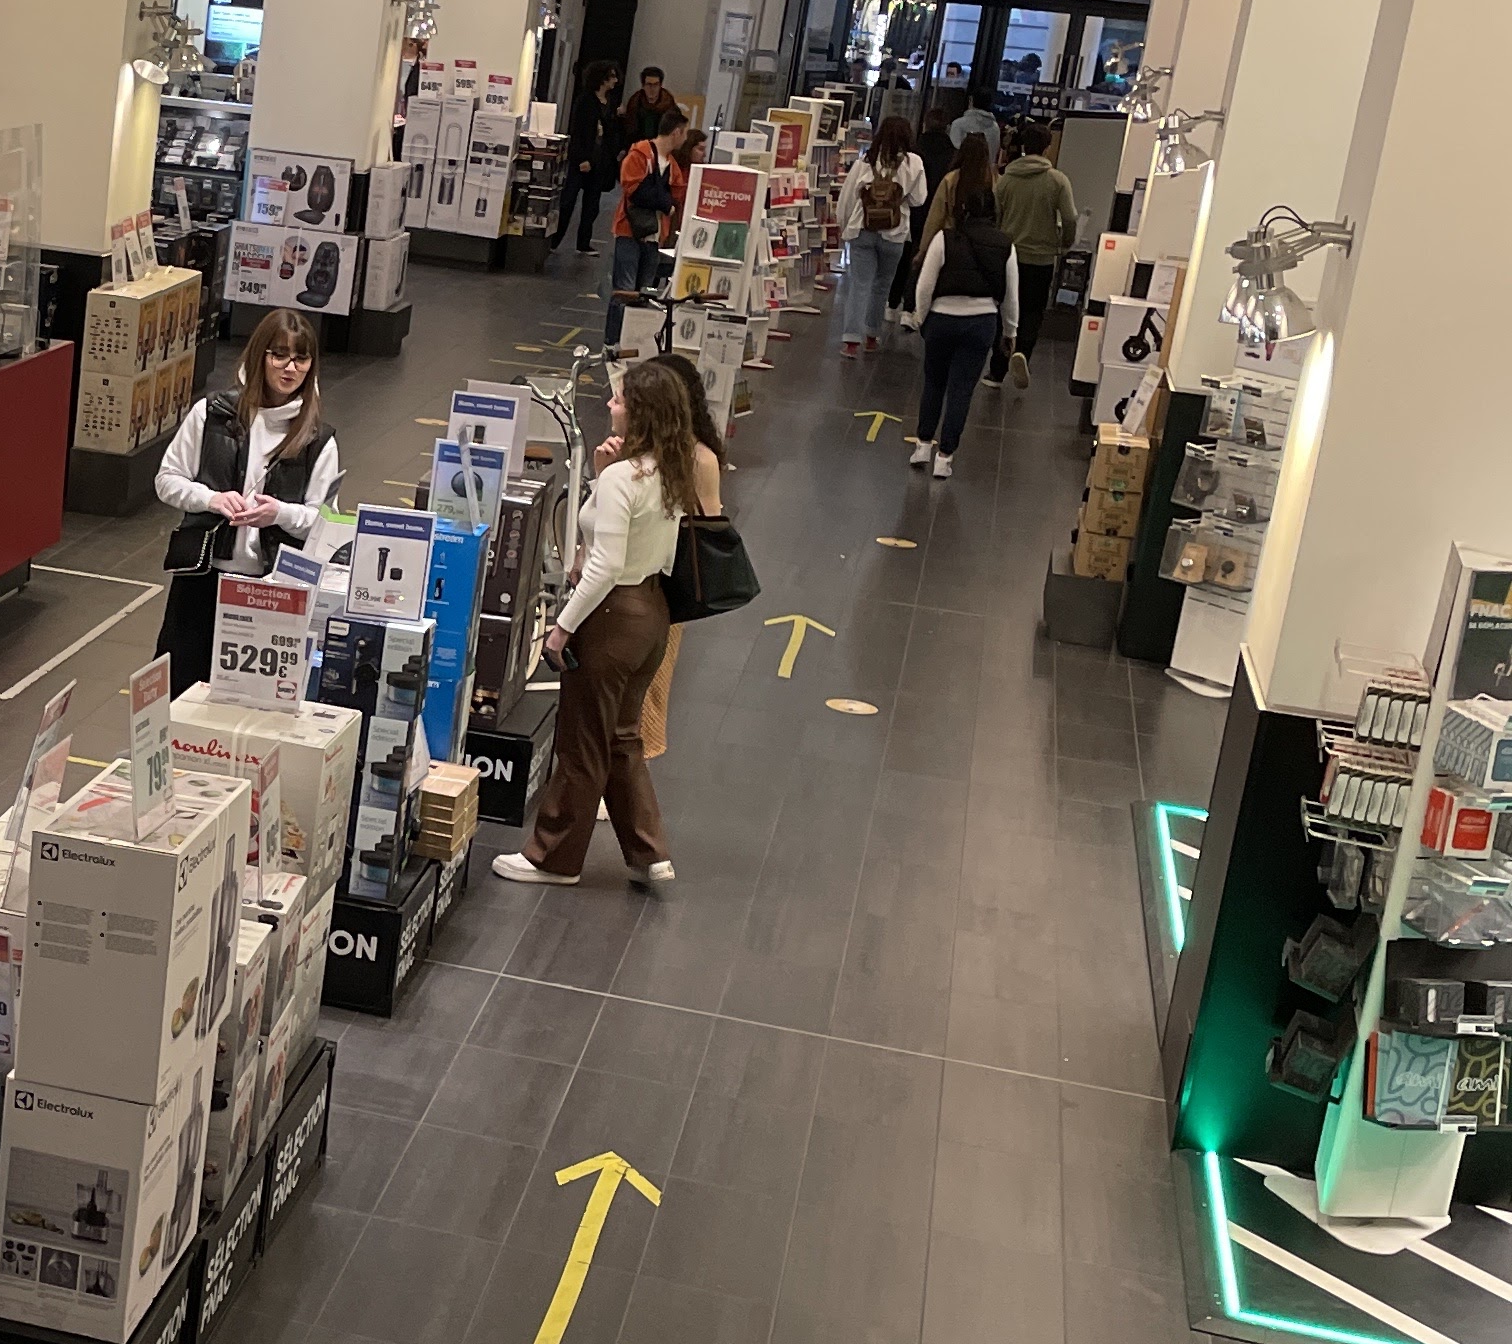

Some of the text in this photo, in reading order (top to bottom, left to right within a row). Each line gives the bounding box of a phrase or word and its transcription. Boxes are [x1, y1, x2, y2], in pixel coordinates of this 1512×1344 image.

[702, 198, 726, 208] FNAC
[703, 188, 751, 202] SÉLECTION
[236, 583, 291, 600] Sélection
[247, 596, 279, 610] Darty
[220, 641, 279, 677] 529
[280, 650, 298, 665] 99
[62, 849, 116, 867] Electrolux
[37, 1098, 94, 1120] Electrolux
[276, 1083, 328, 1181] SÉLECTION
[270, 1157, 301, 1221] FNAC
[205, 1176, 263, 1292] SÉLECTION
[200, 1262, 233, 1334] FNAC
